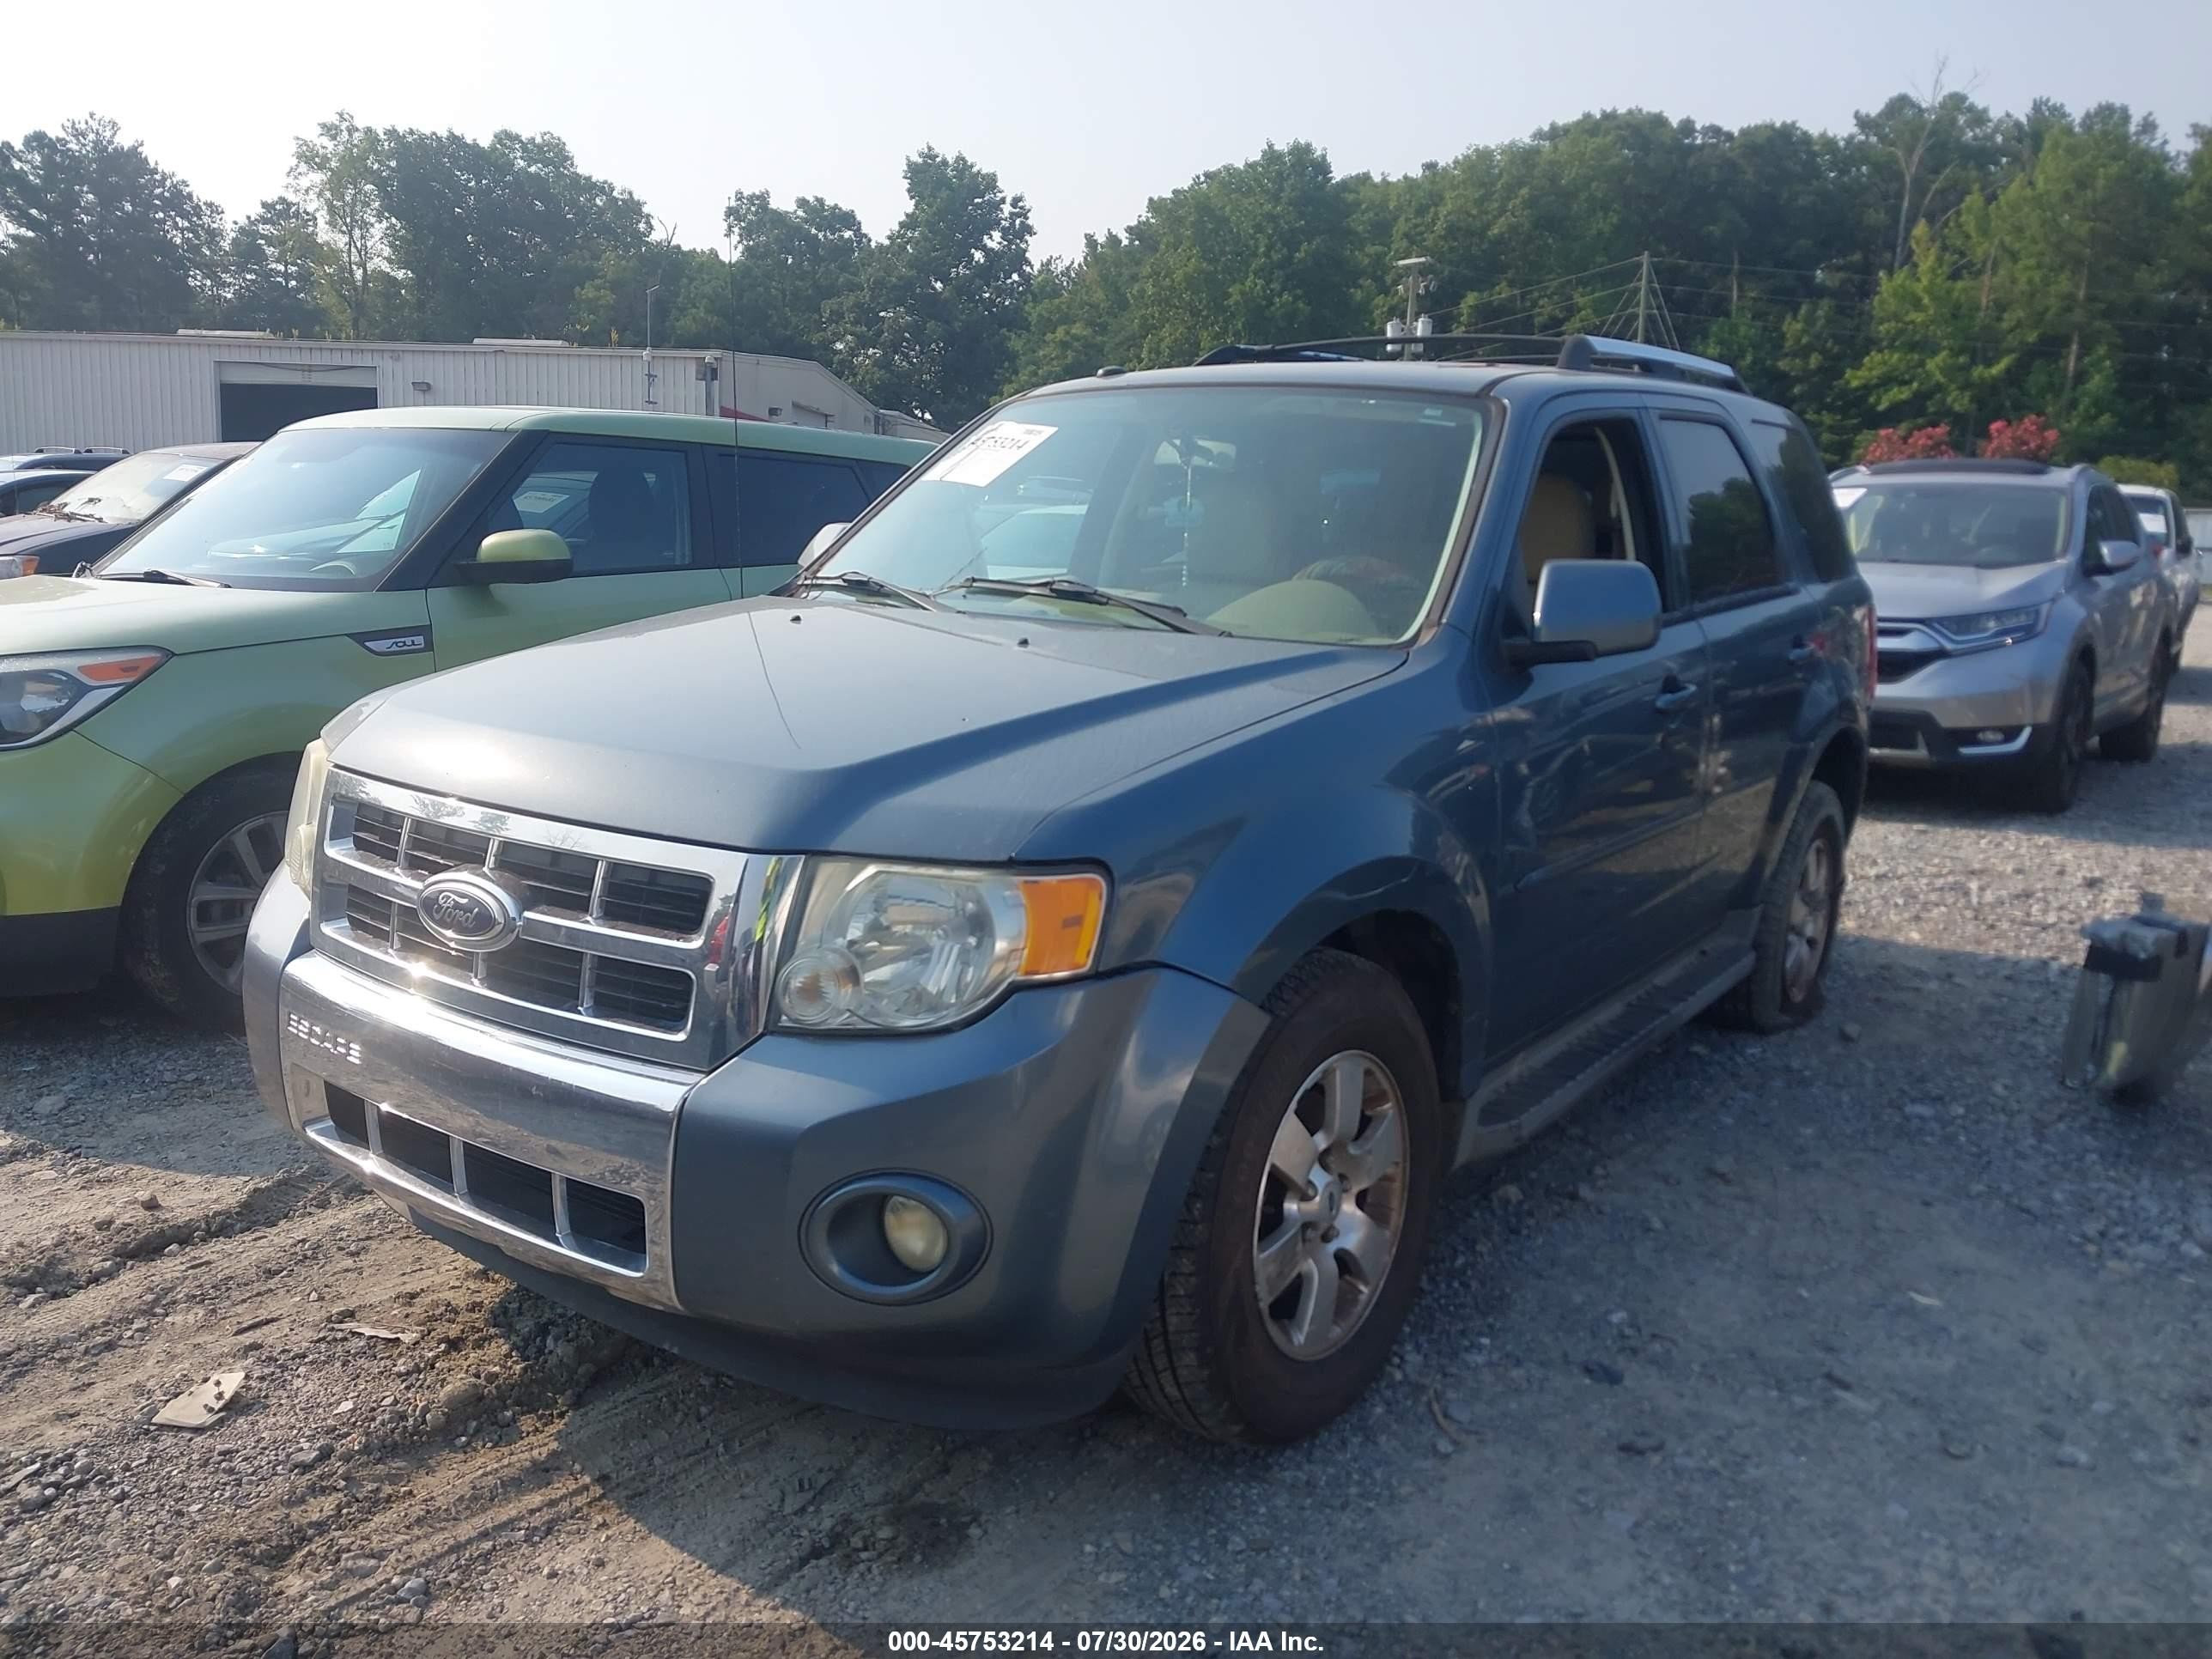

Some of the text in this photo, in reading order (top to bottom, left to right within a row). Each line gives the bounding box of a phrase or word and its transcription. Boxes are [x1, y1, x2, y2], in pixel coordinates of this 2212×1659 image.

[386, 639, 422, 650] SOUL
[432, 891, 479, 928] Ford
[287, 1013, 362, 1065] ESCAPE
